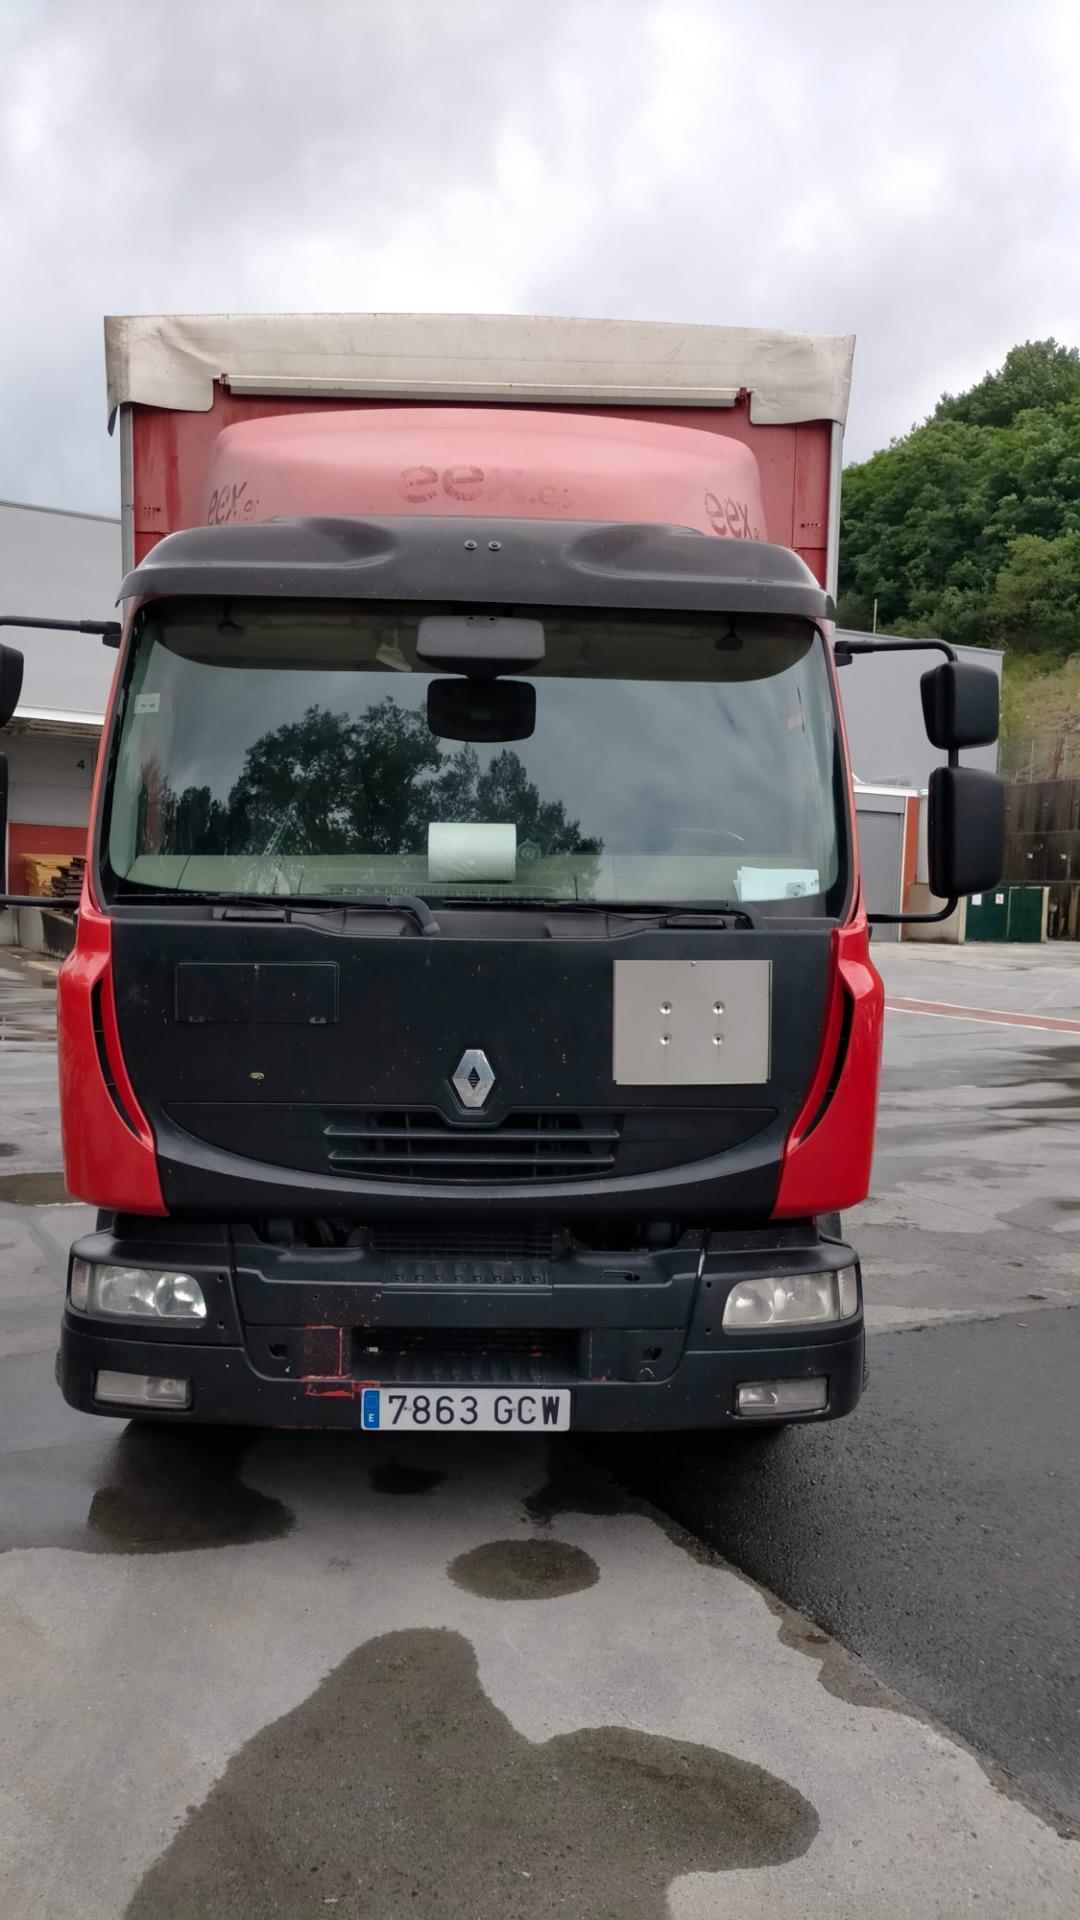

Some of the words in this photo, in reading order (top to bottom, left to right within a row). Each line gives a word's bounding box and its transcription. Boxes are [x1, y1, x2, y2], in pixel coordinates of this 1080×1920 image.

[368, 1413, 375, 1423] E
[388, 1395, 478, 1425] 7863
[494, 1395, 560, 1425] GCW
